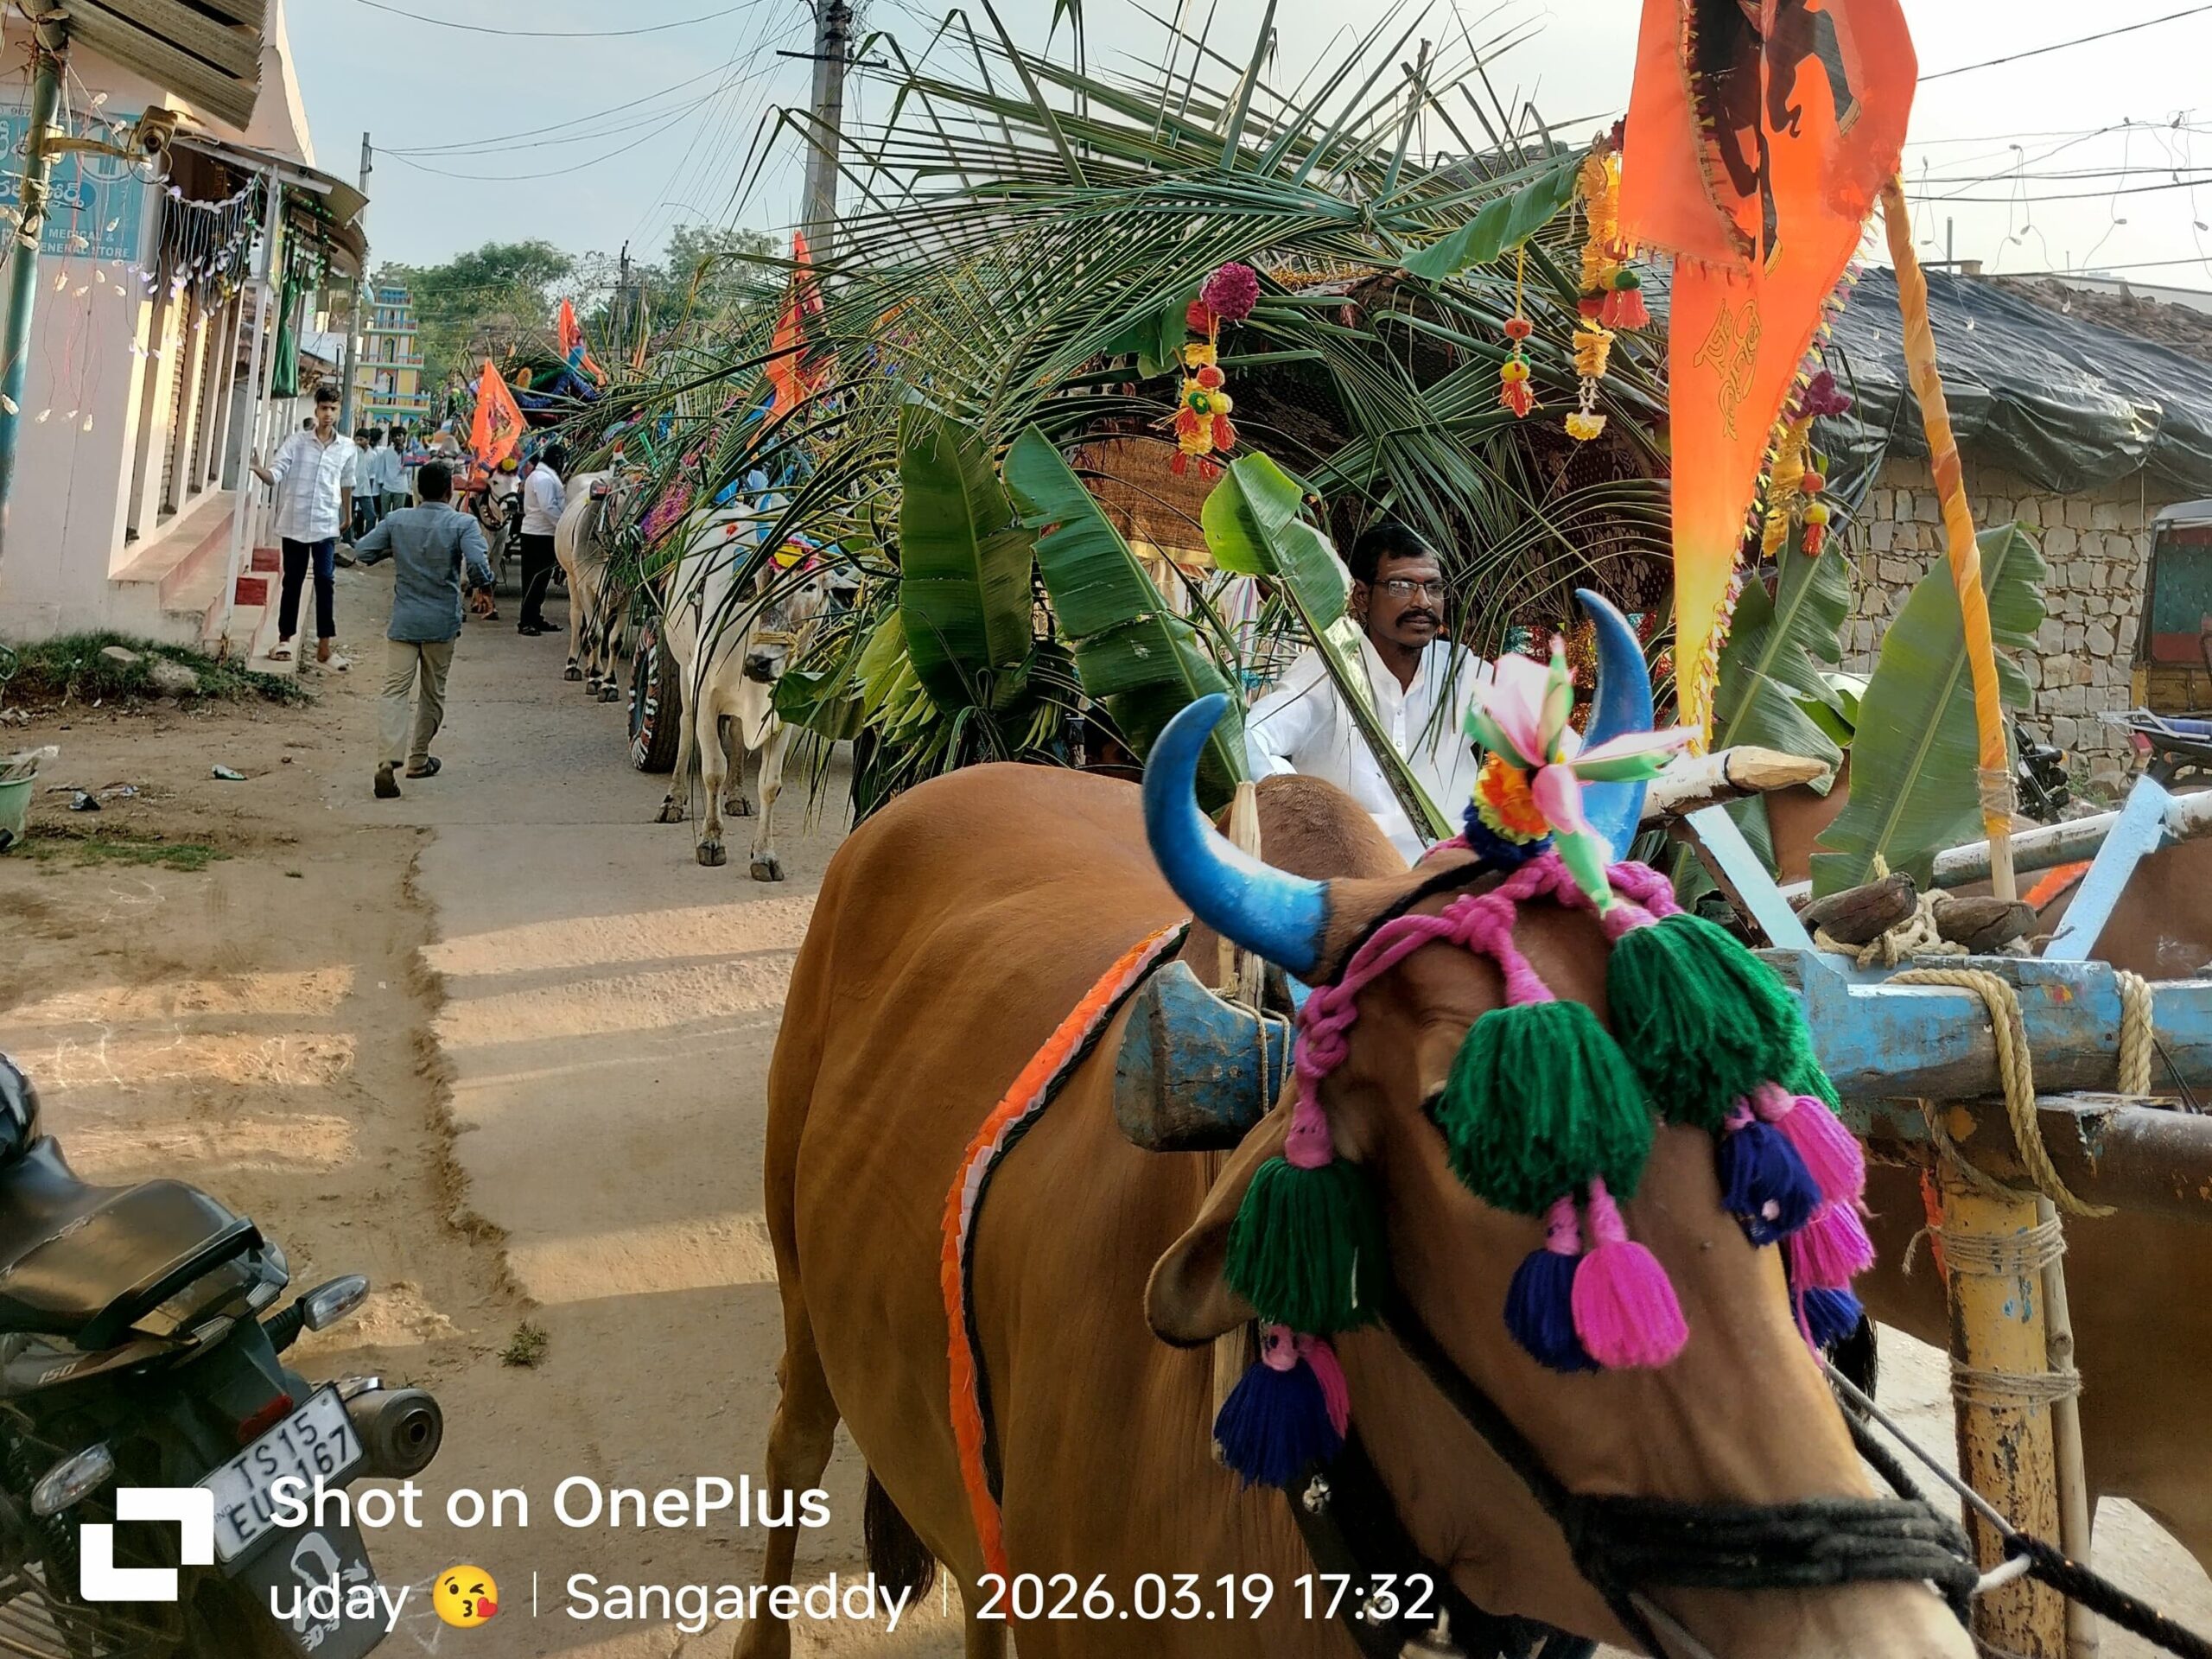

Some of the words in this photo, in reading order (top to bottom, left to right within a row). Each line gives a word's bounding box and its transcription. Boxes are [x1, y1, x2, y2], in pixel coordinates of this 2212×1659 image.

[105, 232, 115, 242] &
[40, 241, 87, 255] ENERAL
[92, 245, 130, 258] STORE
[37, 1362, 77, 1385] 150
[232, 1411, 318, 1491] TS15
